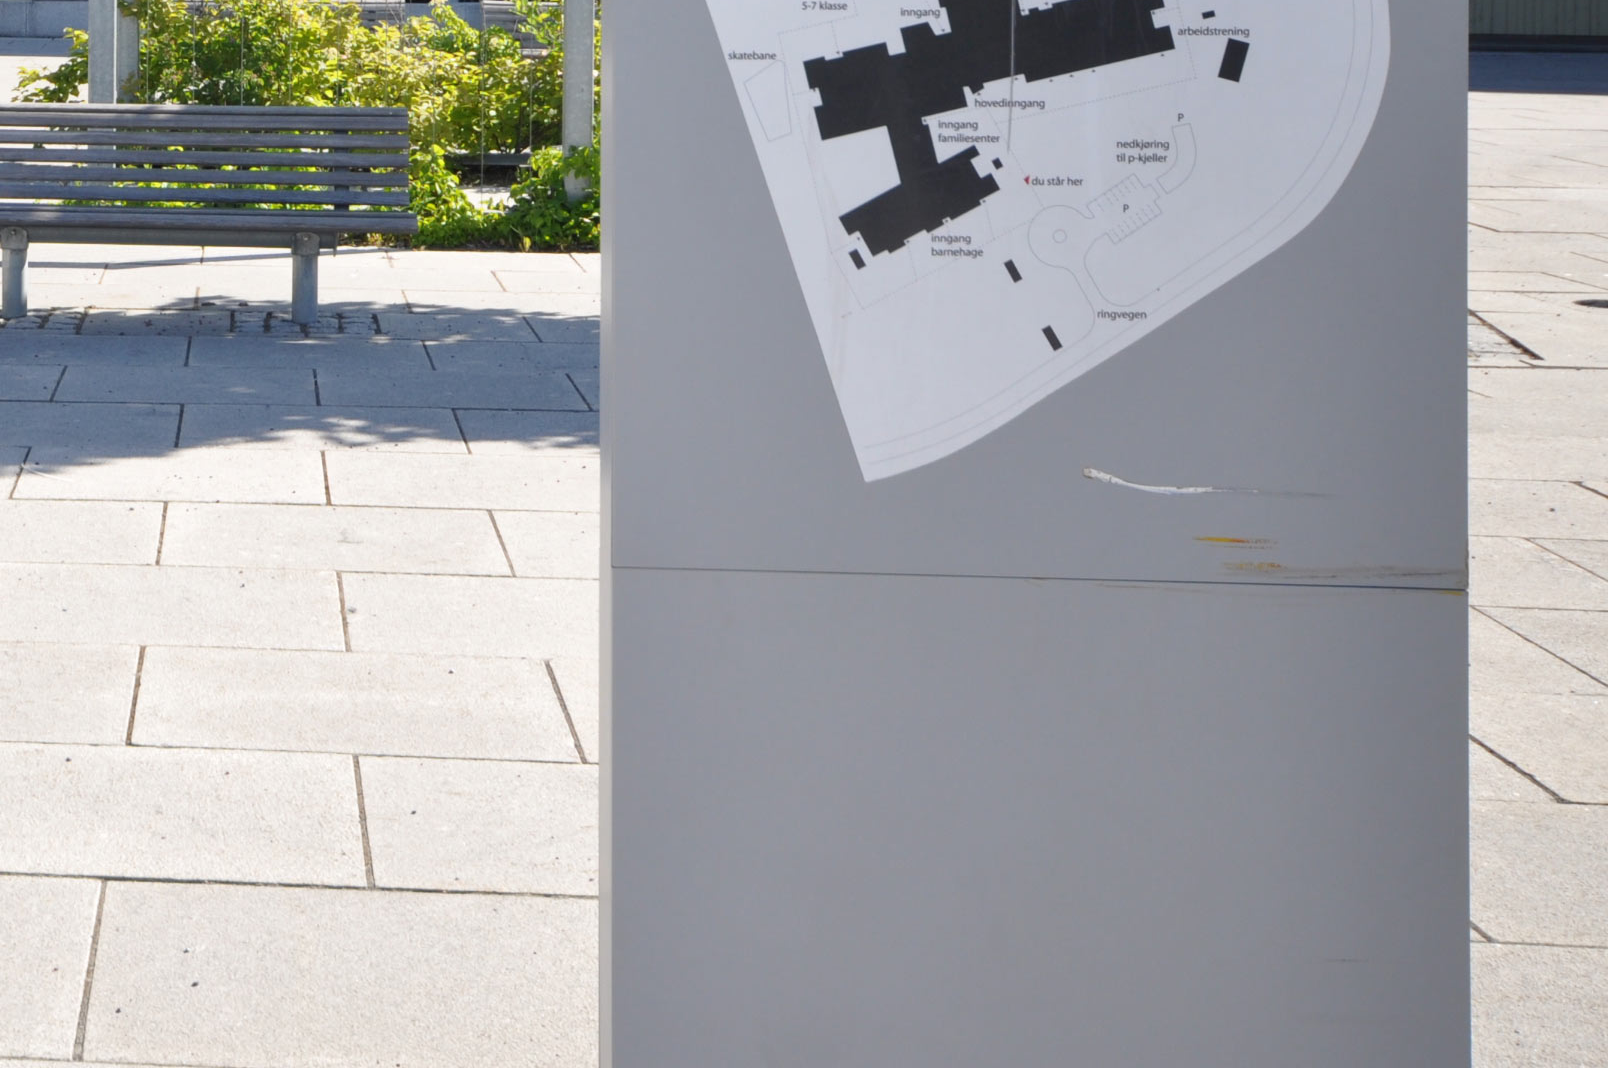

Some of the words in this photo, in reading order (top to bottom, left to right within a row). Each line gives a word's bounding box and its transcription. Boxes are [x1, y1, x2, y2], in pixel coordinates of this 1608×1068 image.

[802, 0, 816, 11] 5-7
[819, 0, 848, 11] klasse
[901, 7, 941, 19] inngang
[1177, 26, 1249, 38] arbeidstrening
[728, 50, 776, 61] skatebane
[974, 98, 1045, 110] hovedinngang
[1177, 113, 1184, 122] P
[938, 120, 978, 132] inngang
[938, 133, 1000, 144] familiesenter
[1116, 139, 1170, 151] nedkjøring
[1116, 153, 1125, 163] til
[1128, 152, 1167, 164] p-kjeller
[1032, 177, 1044, 186] du
[1047, 176, 1065, 186] står
[1067, 177, 1083, 186] her
[1123, 204, 1129, 213] P
[931, 234, 972, 245] inngang
[931, 247, 983, 258] barnehage
[1097, 309, 1147, 321] ringvegen
